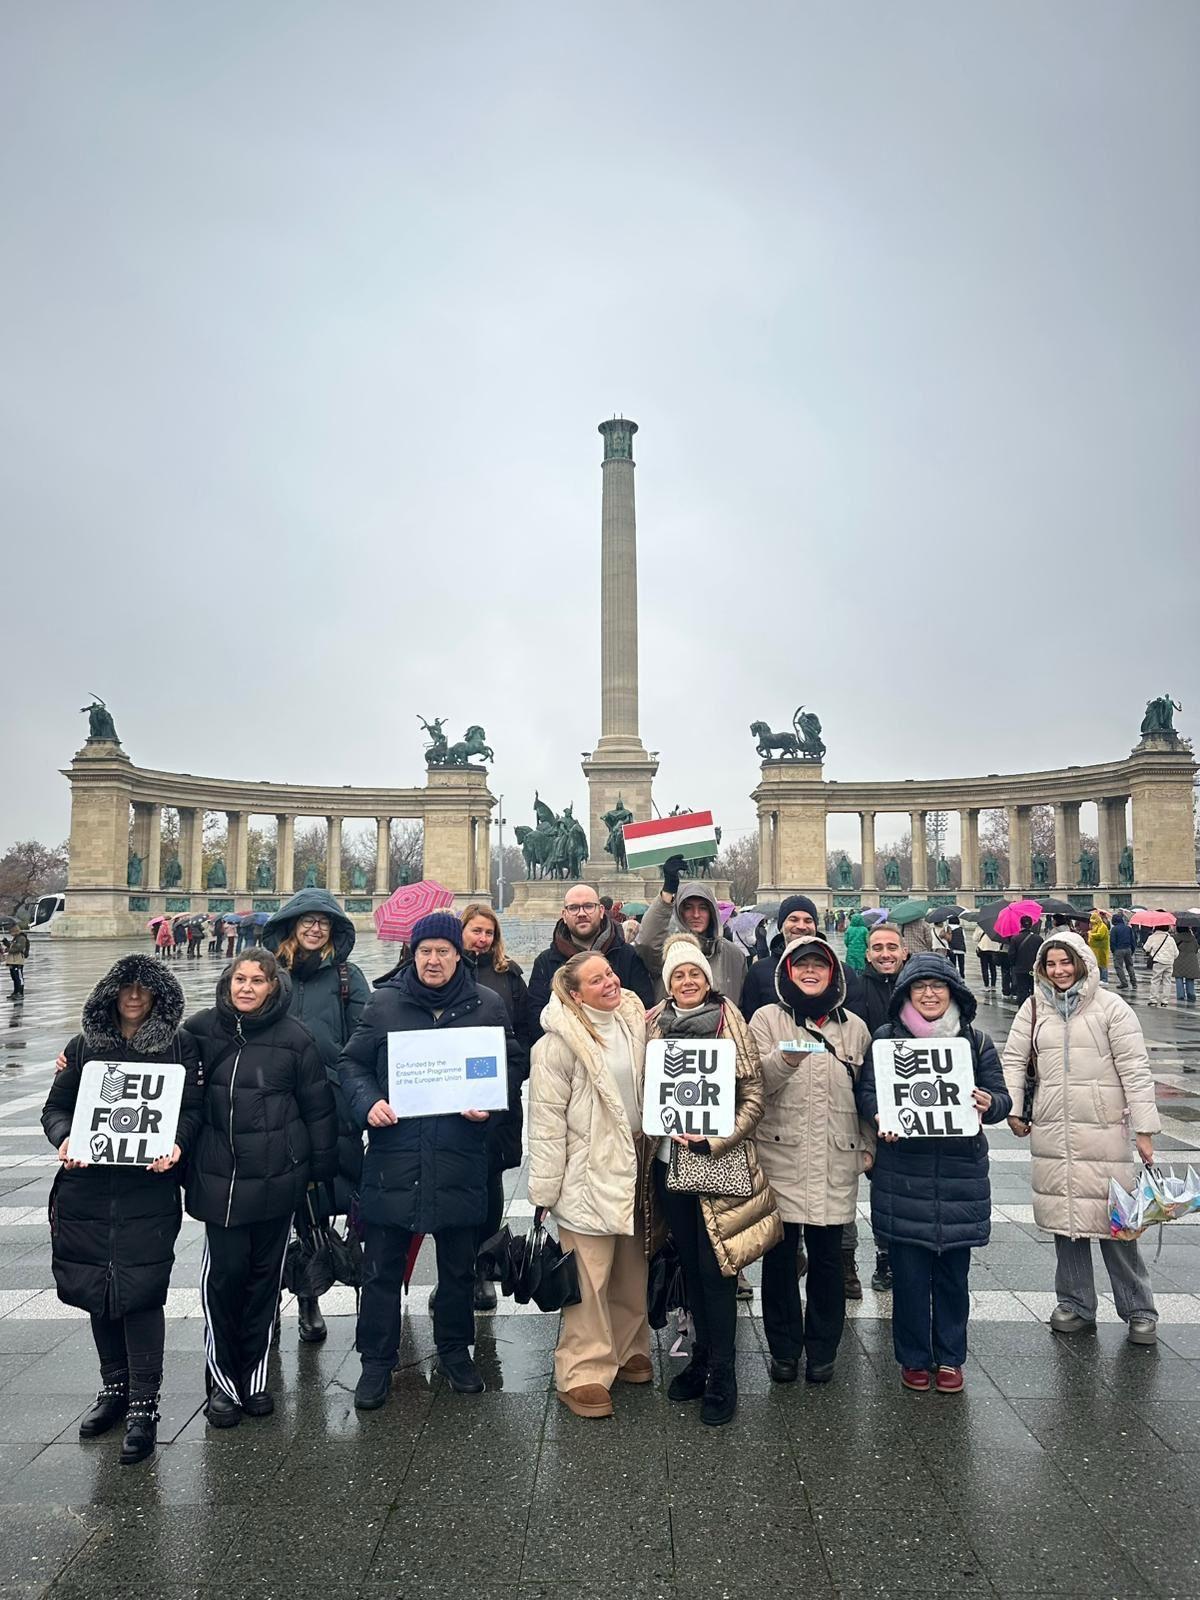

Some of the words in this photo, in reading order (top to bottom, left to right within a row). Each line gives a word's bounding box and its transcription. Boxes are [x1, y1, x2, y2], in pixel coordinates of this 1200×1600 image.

[396, 1061, 427, 1069] Co-funded
[396, 1069, 426, 1077] Erasmus+
[427, 1067, 462, 1075] Programme
[683, 1050, 718, 1074] EU
[914, 1049, 953, 1074] EU
[121, 1074, 165, 1100] EU
[414, 1076, 444, 1084] European
[445, 1074, 462, 1082] Union
[660, 1082, 720, 1106] FOR
[893, 1082, 961, 1106] FOR
[90, 1107, 162, 1133] FOR
[661, 1108, 719, 1135] ALL
[898, 1109, 963, 1135] ALL
[90, 1135, 155, 1163] ALL
